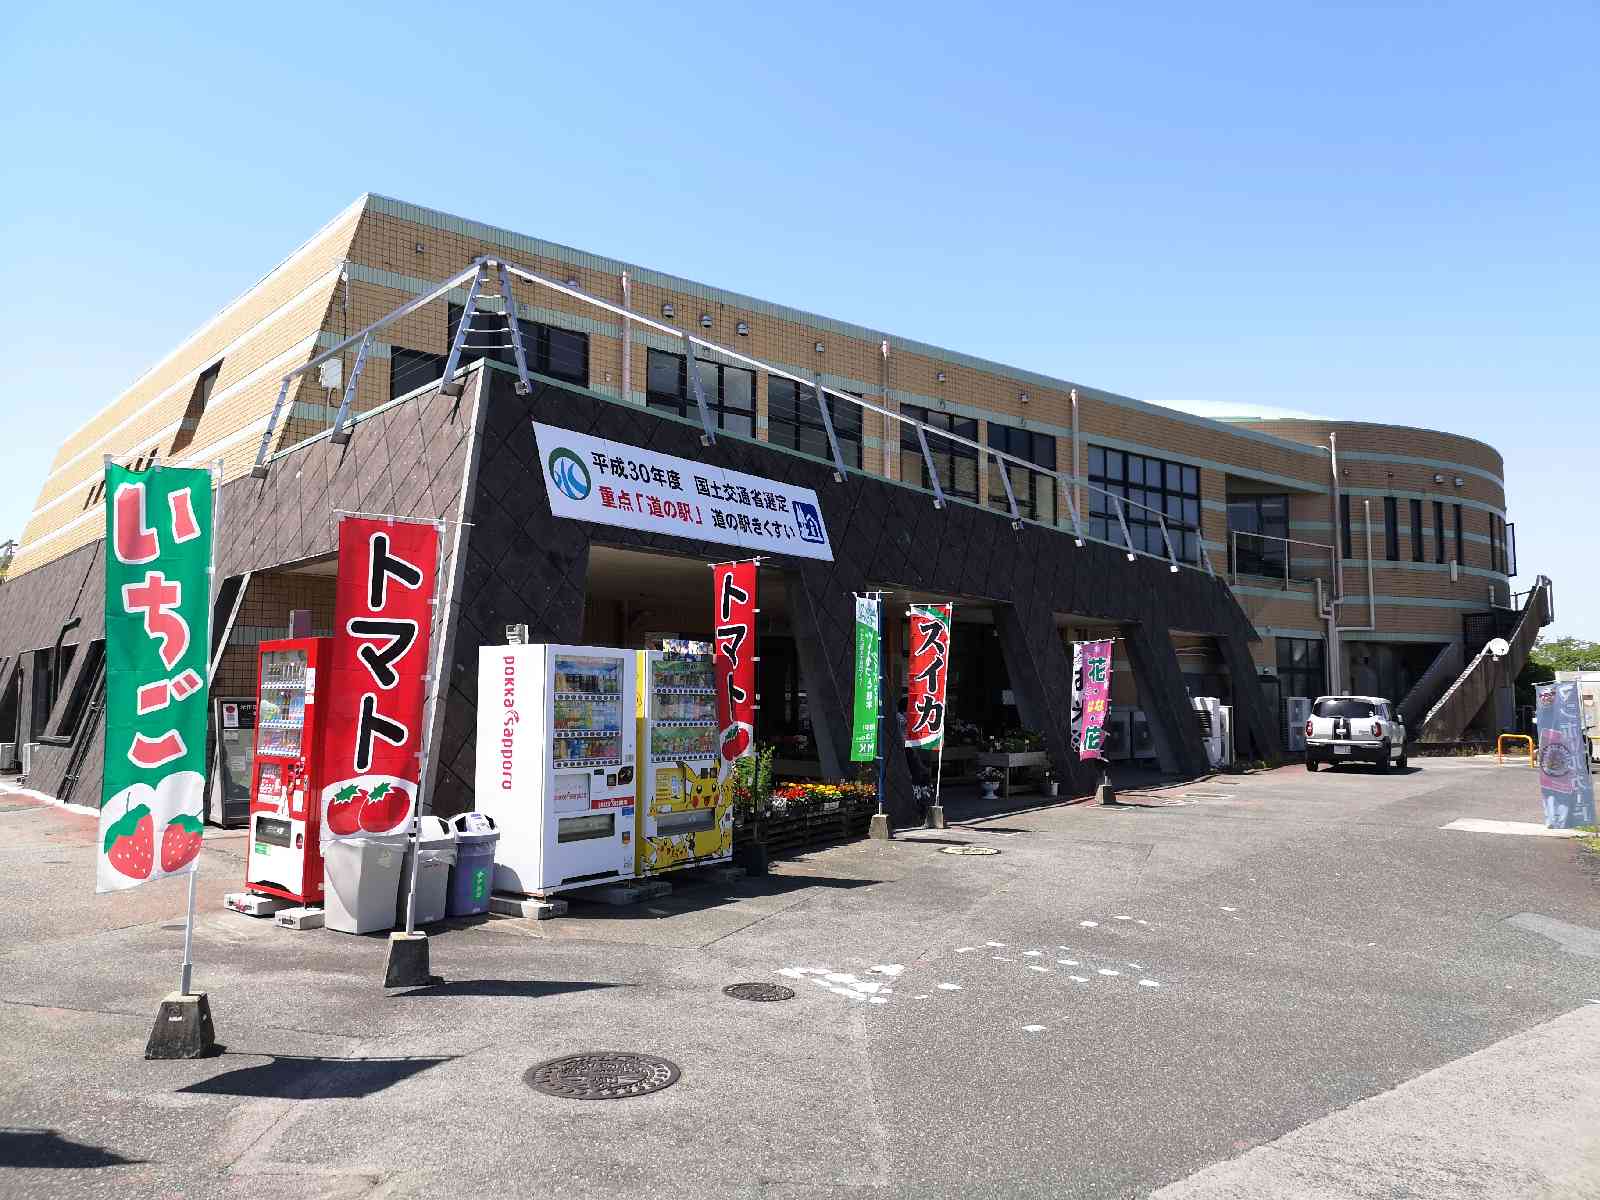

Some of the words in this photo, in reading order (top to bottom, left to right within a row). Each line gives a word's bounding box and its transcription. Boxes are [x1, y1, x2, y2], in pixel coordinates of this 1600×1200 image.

[591, 451, 684, 491] 平成30年度
[694, 475, 790, 513] 国土交通省選定
[599, 485, 703, 525] 重点「道の駅」
[711, 507, 796, 540] 道の駅きくすい
[113, 482, 204, 769] いちご
[347, 532, 421, 772] トマト
[717, 572, 749, 721] トマト
[912, 621, 946, 733] スイカ
